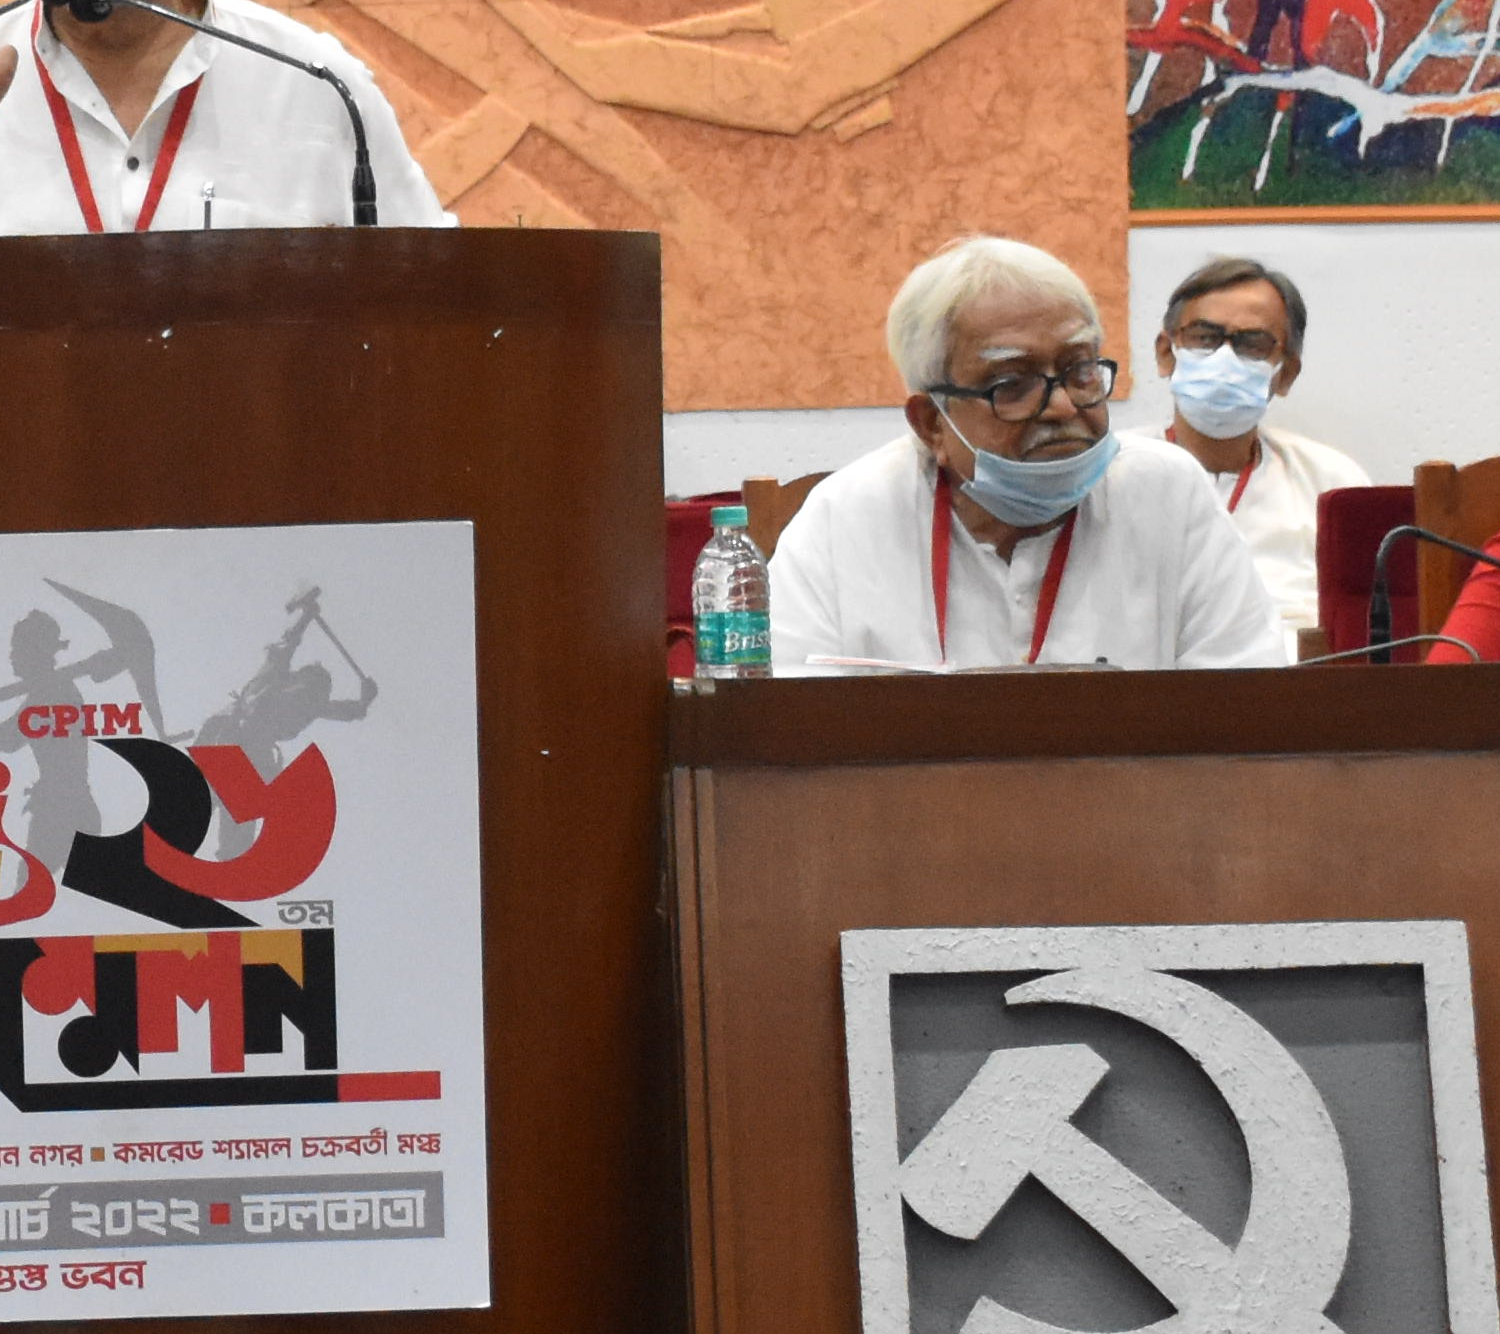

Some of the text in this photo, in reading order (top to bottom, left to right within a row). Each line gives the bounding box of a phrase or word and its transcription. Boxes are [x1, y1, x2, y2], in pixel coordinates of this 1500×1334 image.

[17, 703, 143, 739] CPIM
[277, 899, 336, 926] তম
[29, 1144, 83, 1167] নগর
[113, 1139, 203, 1164] কমরেড
[212, 1136, 291, 1161] শ্যামল
[301, 1127, 388, 1159] চক্রবর্তী
[396, 1132, 442, 1155] মঞ্চ
[71, 1197, 200, 1239] ২০২২
[240, 1189, 426, 1234] কলকাতা
[59, 1260, 147, 1289] ভবন
